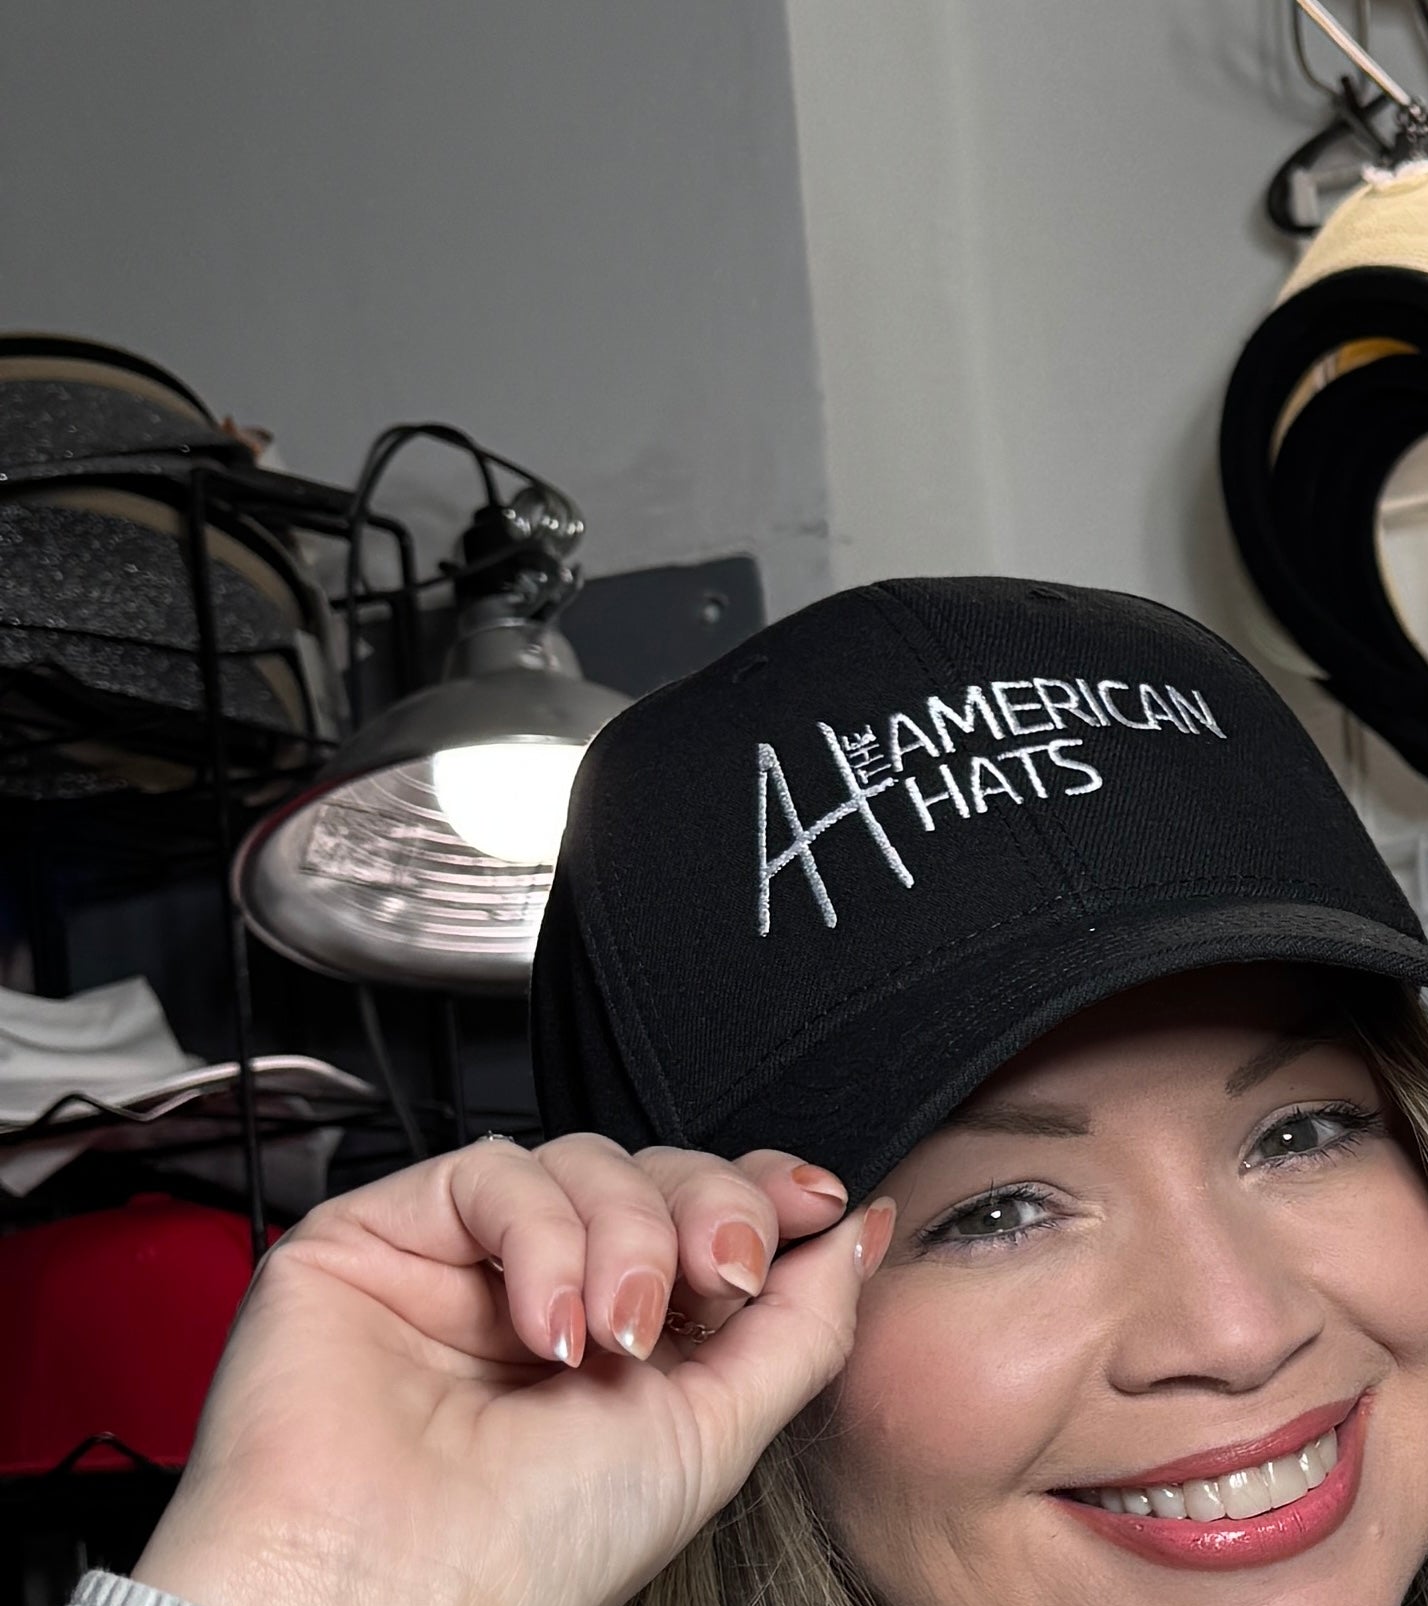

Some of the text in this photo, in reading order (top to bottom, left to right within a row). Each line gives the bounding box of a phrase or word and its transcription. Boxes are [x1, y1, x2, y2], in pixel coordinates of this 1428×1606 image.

[841, 723, 893, 785] THE
[886, 677, 1228, 774] AMERICAN
[904, 738, 1104, 832] HATS
